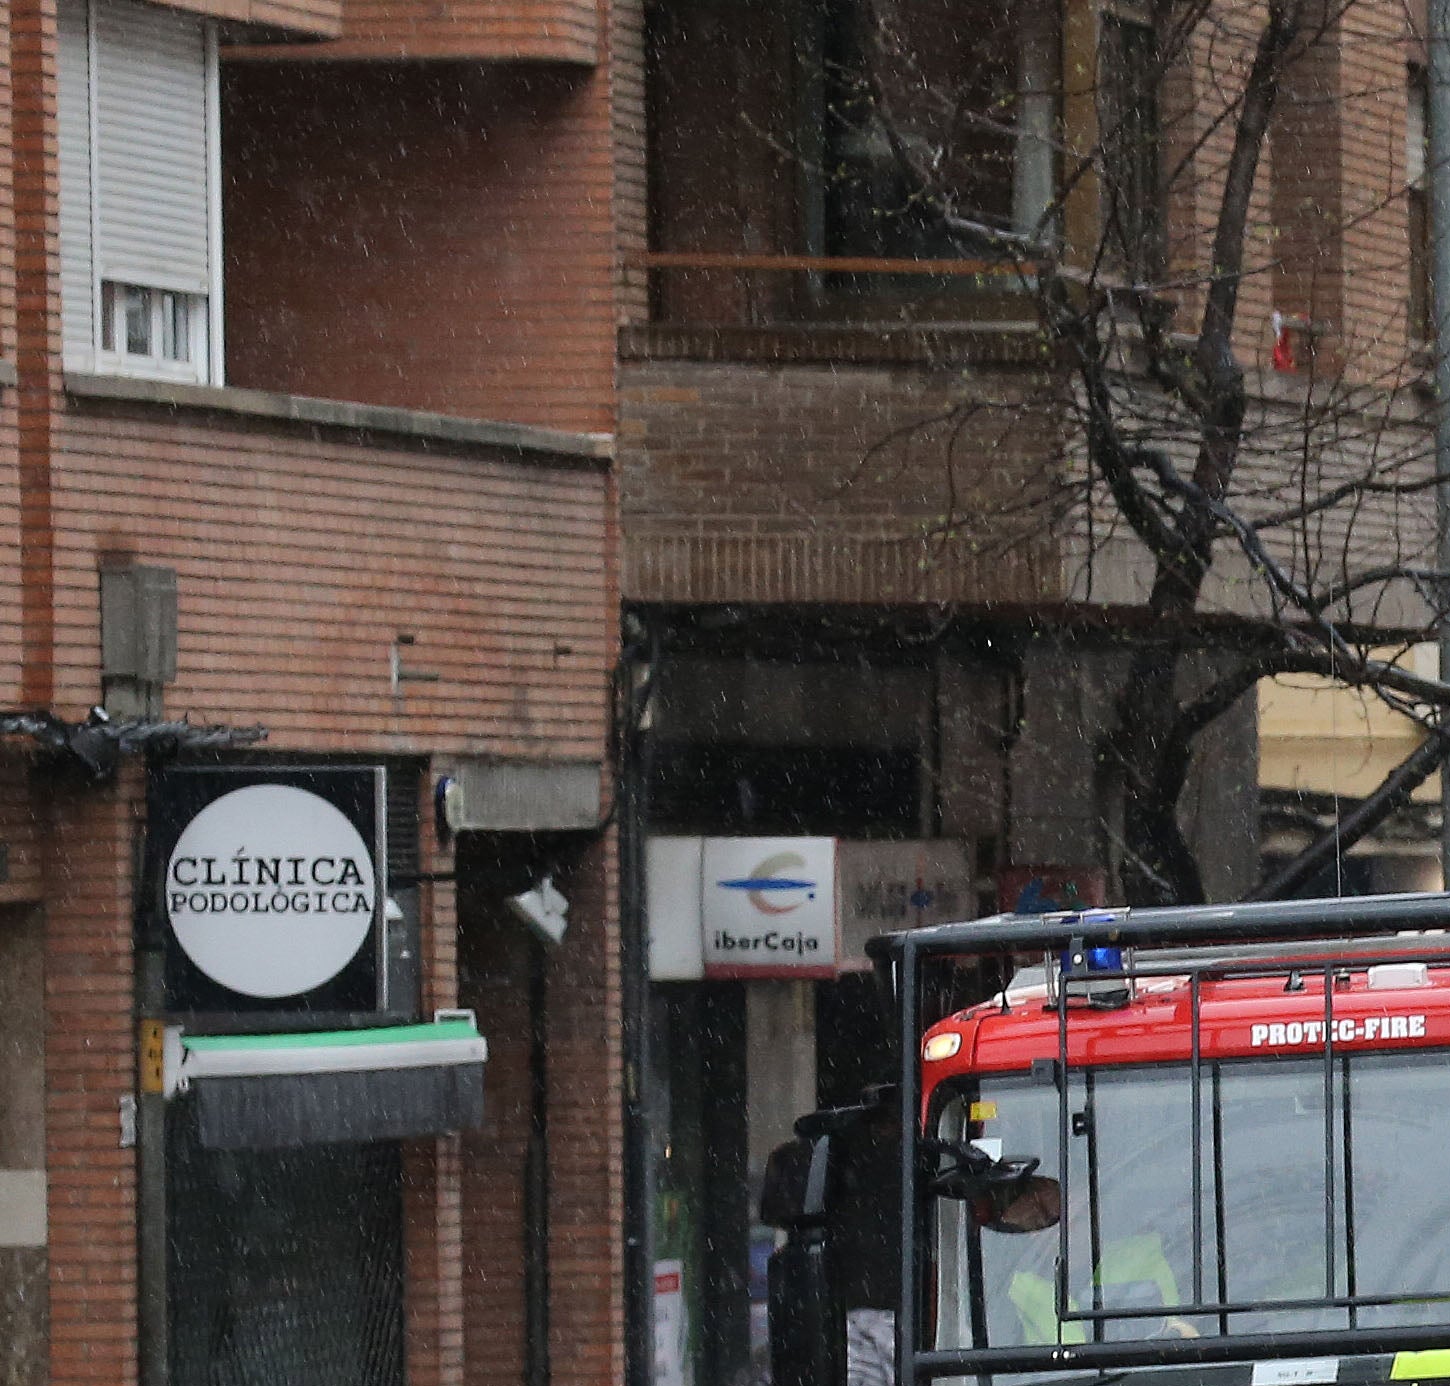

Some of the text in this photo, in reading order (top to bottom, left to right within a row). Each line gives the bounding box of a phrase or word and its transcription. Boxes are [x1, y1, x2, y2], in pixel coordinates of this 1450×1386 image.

[173, 847, 365, 886] CLÍNICA
[170, 885, 370, 914] PODOLÓGICA
[715, 930, 818, 957] iberCaja
[1251, 1014, 1427, 1047] PROTEC-FIRE
